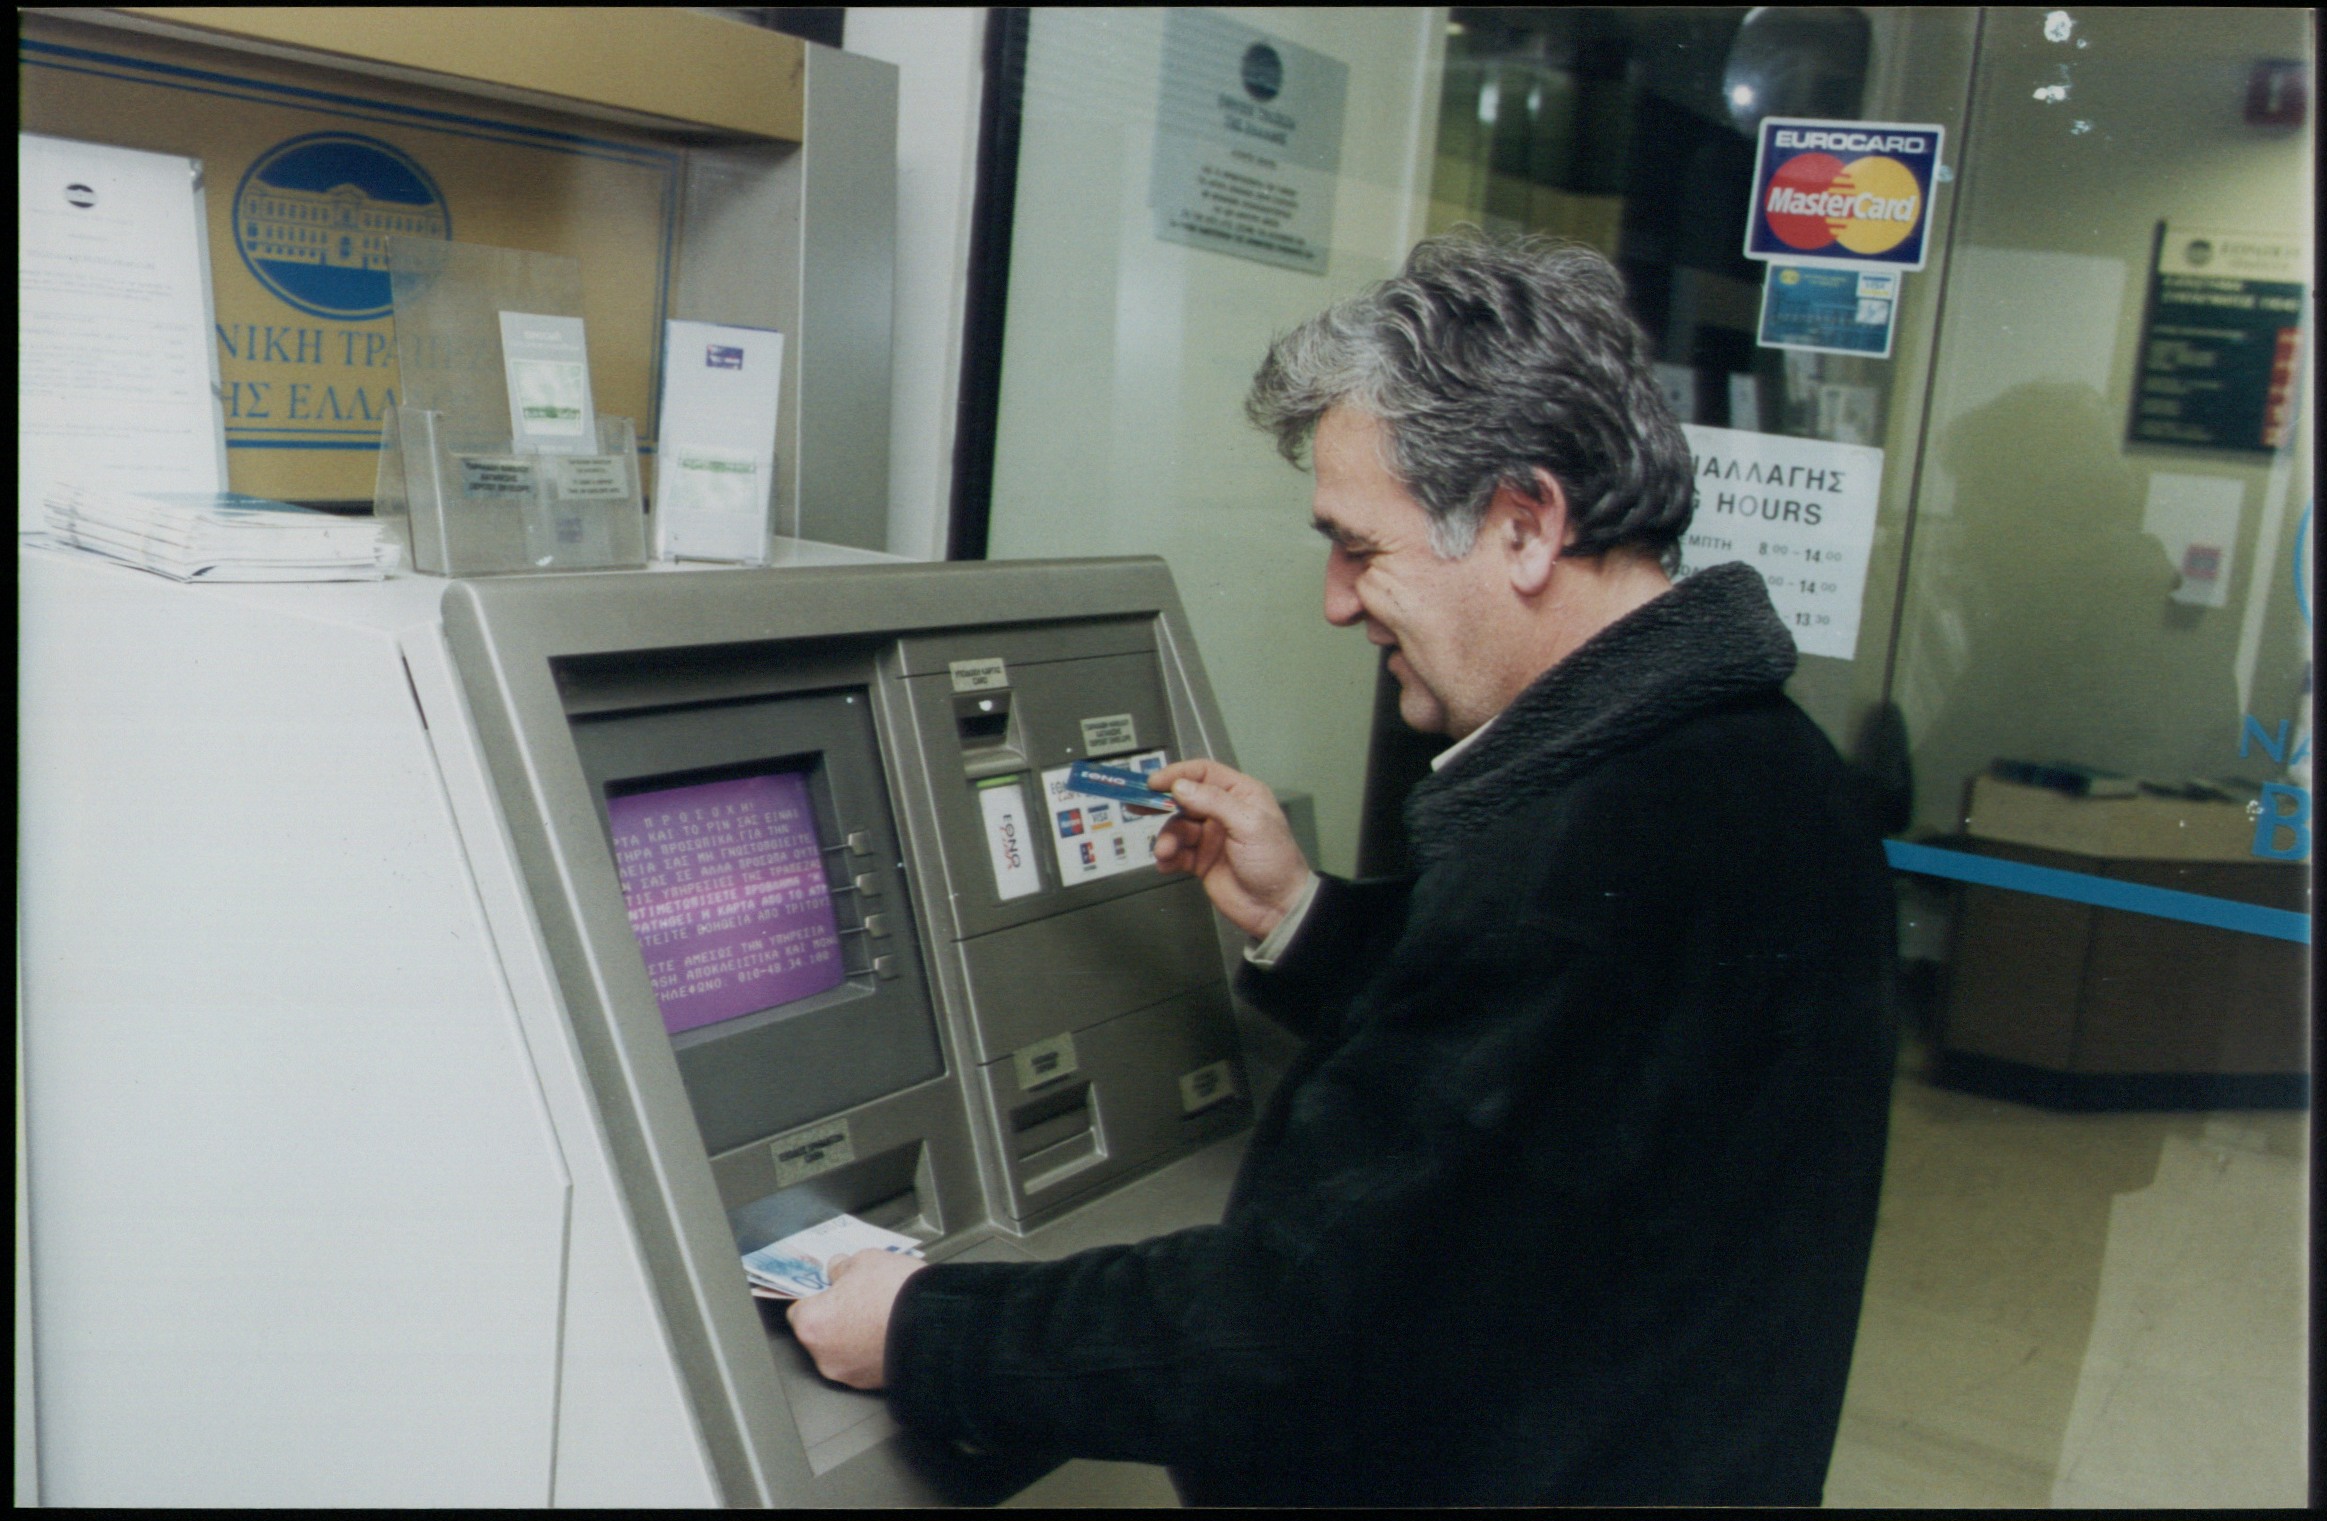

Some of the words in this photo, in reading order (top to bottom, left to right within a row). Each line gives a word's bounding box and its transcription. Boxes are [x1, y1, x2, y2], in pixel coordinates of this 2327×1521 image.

[1775, 130, 1926, 154] EUROCARD
[1766, 186, 1917, 222] MasterCard
[1716, 492, 1822, 526] HOURS
